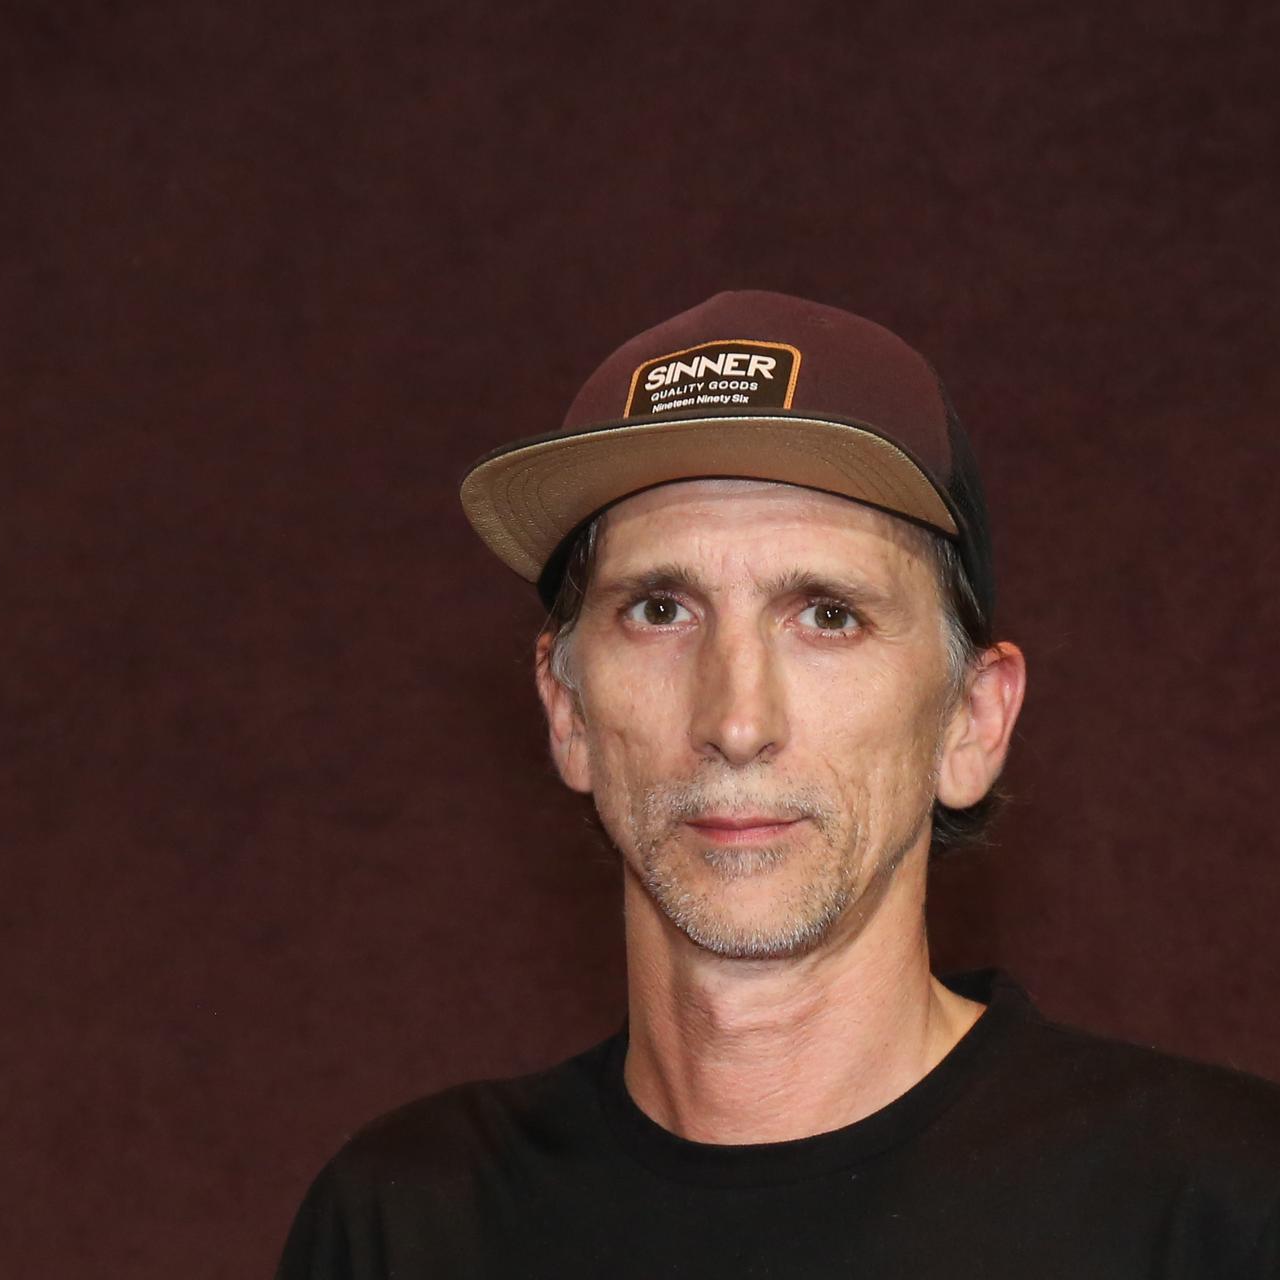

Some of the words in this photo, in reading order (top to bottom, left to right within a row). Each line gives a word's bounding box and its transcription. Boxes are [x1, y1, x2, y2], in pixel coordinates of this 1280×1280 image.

[644, 353, 777, 392] SINNER
[650, 381, 705, 402] QUALITY
[708, 380, 759, 391] GOODS
[651, 397, 695, 414] Nineteen
[696, 394, 731, 404] Ninety
[732, 394, 749, 404] Six
